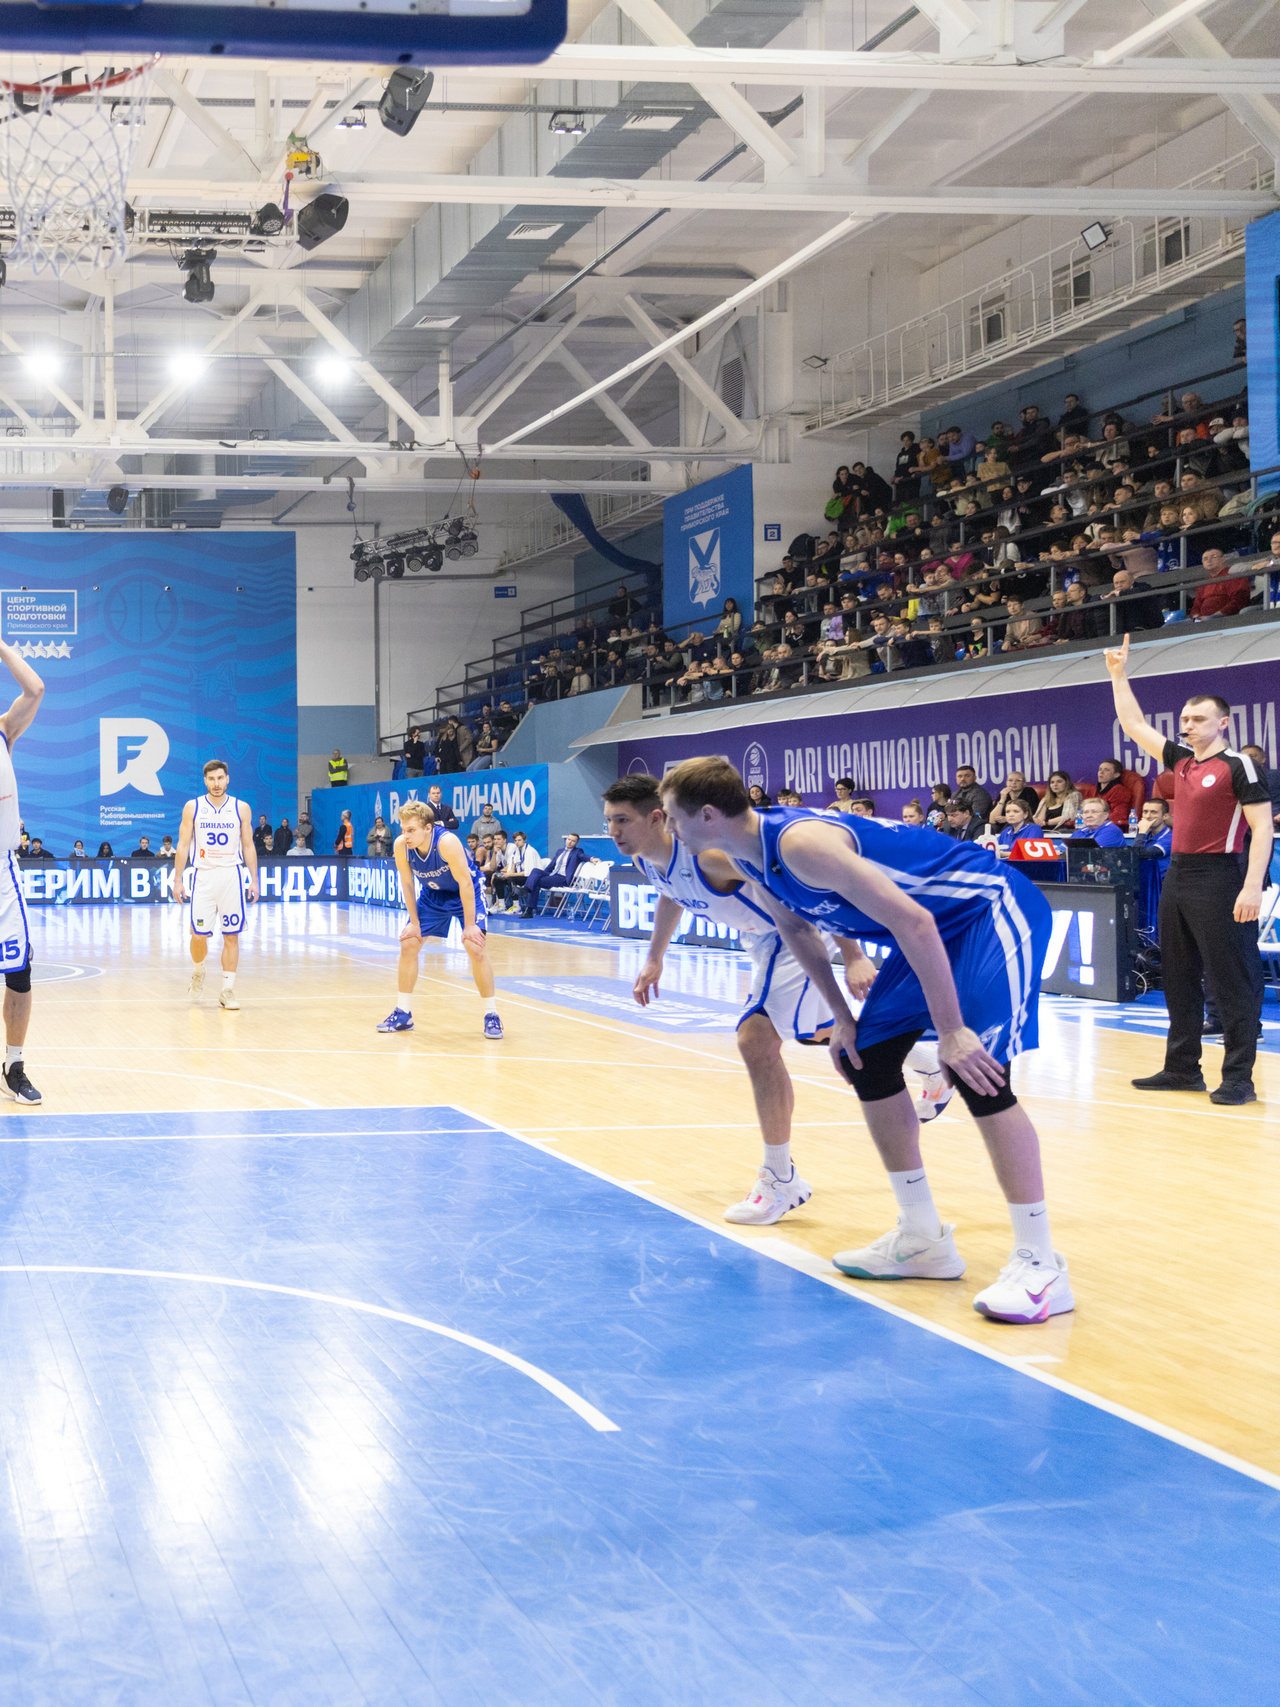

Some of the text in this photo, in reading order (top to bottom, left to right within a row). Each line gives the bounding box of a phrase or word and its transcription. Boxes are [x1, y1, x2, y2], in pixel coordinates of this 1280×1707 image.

[7, 596, 36, 604] ЦЕНТР
[7, 603, 67, 612] СПОРТИВНОЙ
[7, 613, 66, 621] ПОДГОТОВКИ
[784, 746, 822, 794] PARI
[452, 779, 536, 822] ДИНАМО
[100, 805, 126, 813] Русская
[100, 812, 165, 820] Рыбопромышленная
[206, 832, 229, 846] 30
[20, 866, 337, 902] ЕРИМ В КОАНДУ!
[348, 866, 386, 903] ВЕРИМ
[223, 914, 240, 927] 30
